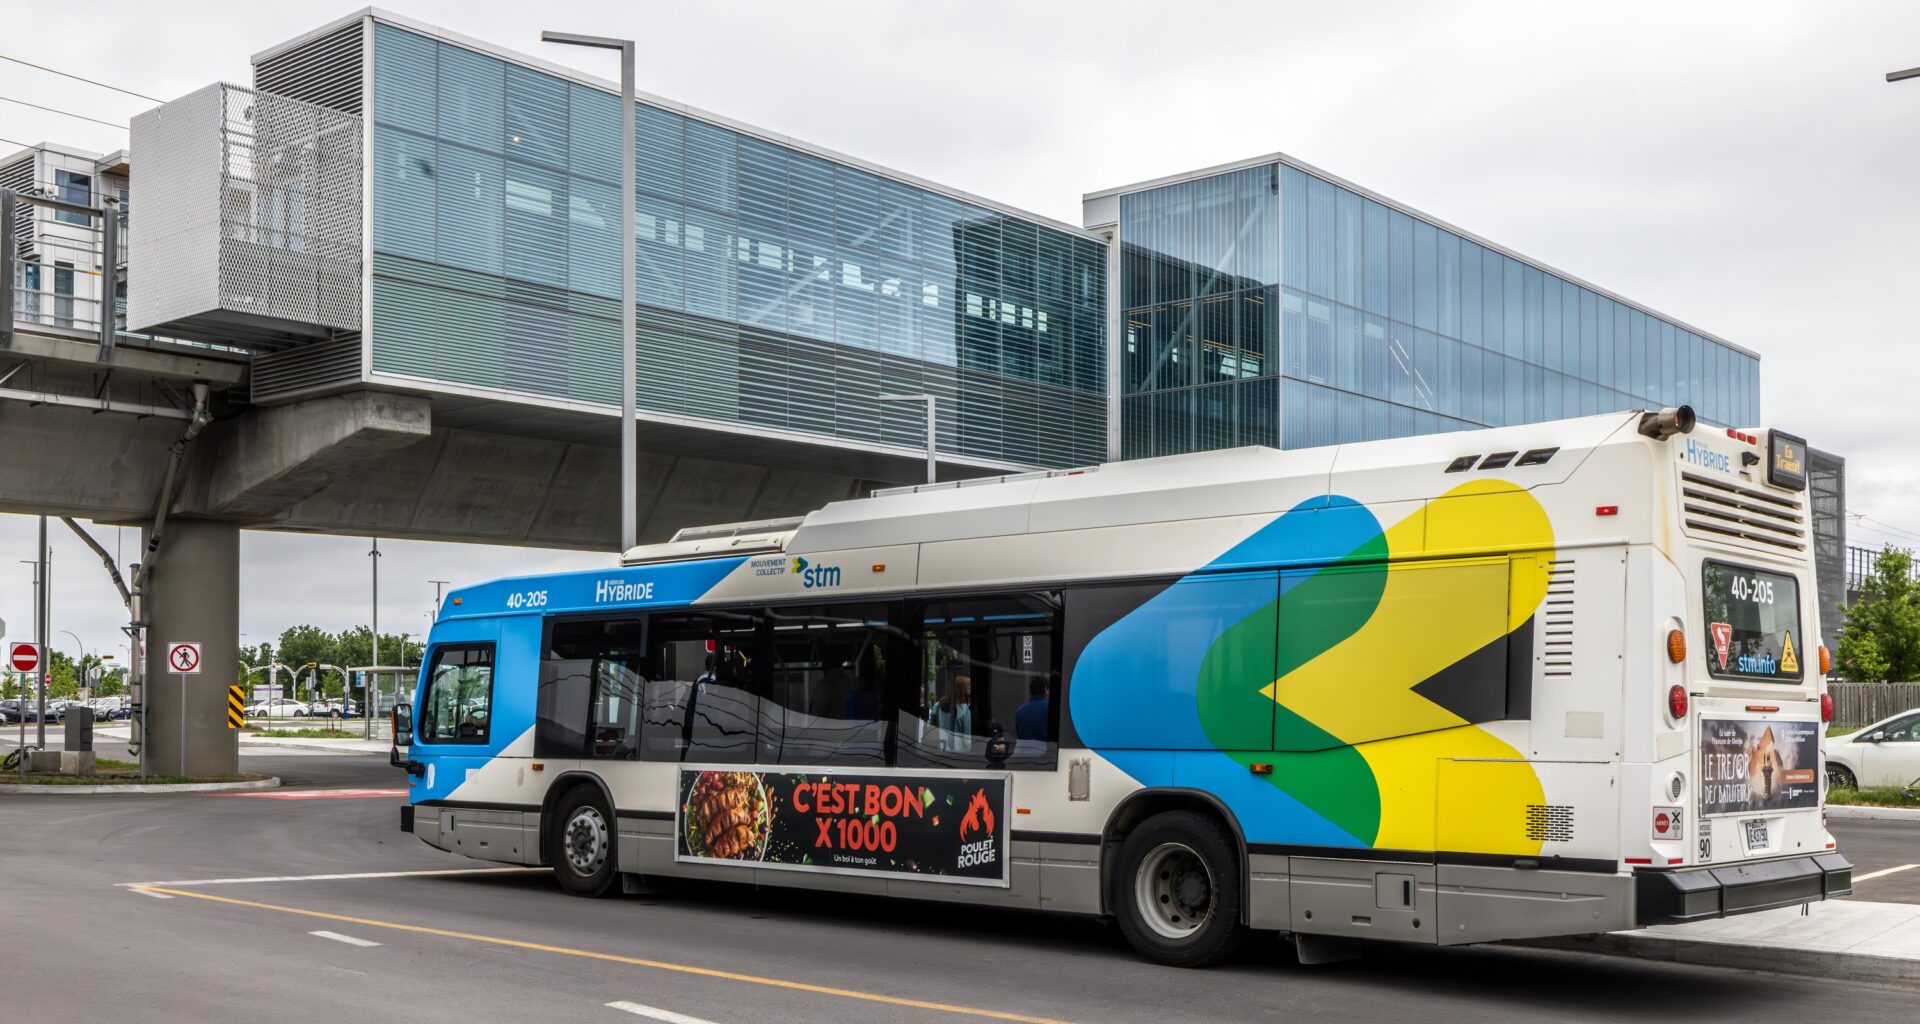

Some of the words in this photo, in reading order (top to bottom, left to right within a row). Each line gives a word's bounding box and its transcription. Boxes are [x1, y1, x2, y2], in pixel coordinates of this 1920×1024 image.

[1686, 437, 1730, 473] HYBRIDE
[750, 558, 786, 568] MOUVEMENT
[756, 567, 785, 576] COLLECTIF
[803, 563, 841, 588] stm
[506, 590, 547, 609] 40-205
[595, 579, 654, 603] HYBRIDE
[1731, 575, 1774, 605] 40-205
[1738, 653, 1776, 674] stm.info
[1704, 753, 1713, 781] LE
[792, 783, 860, 814] C'EST
[864, 784, 925, 818] BON
[1704, 785, 1717, 805] DES
[815, 817, 833, 848] X
[836, 818, 897, 852] 1000
[960, 839, 994, 856] POULET
[1699, 838, 1711, 859] 90
[833, 854, 842, 862] Un
[842, 855, 850, 863] bol
[957, 849, 996, 869] ROUGE
